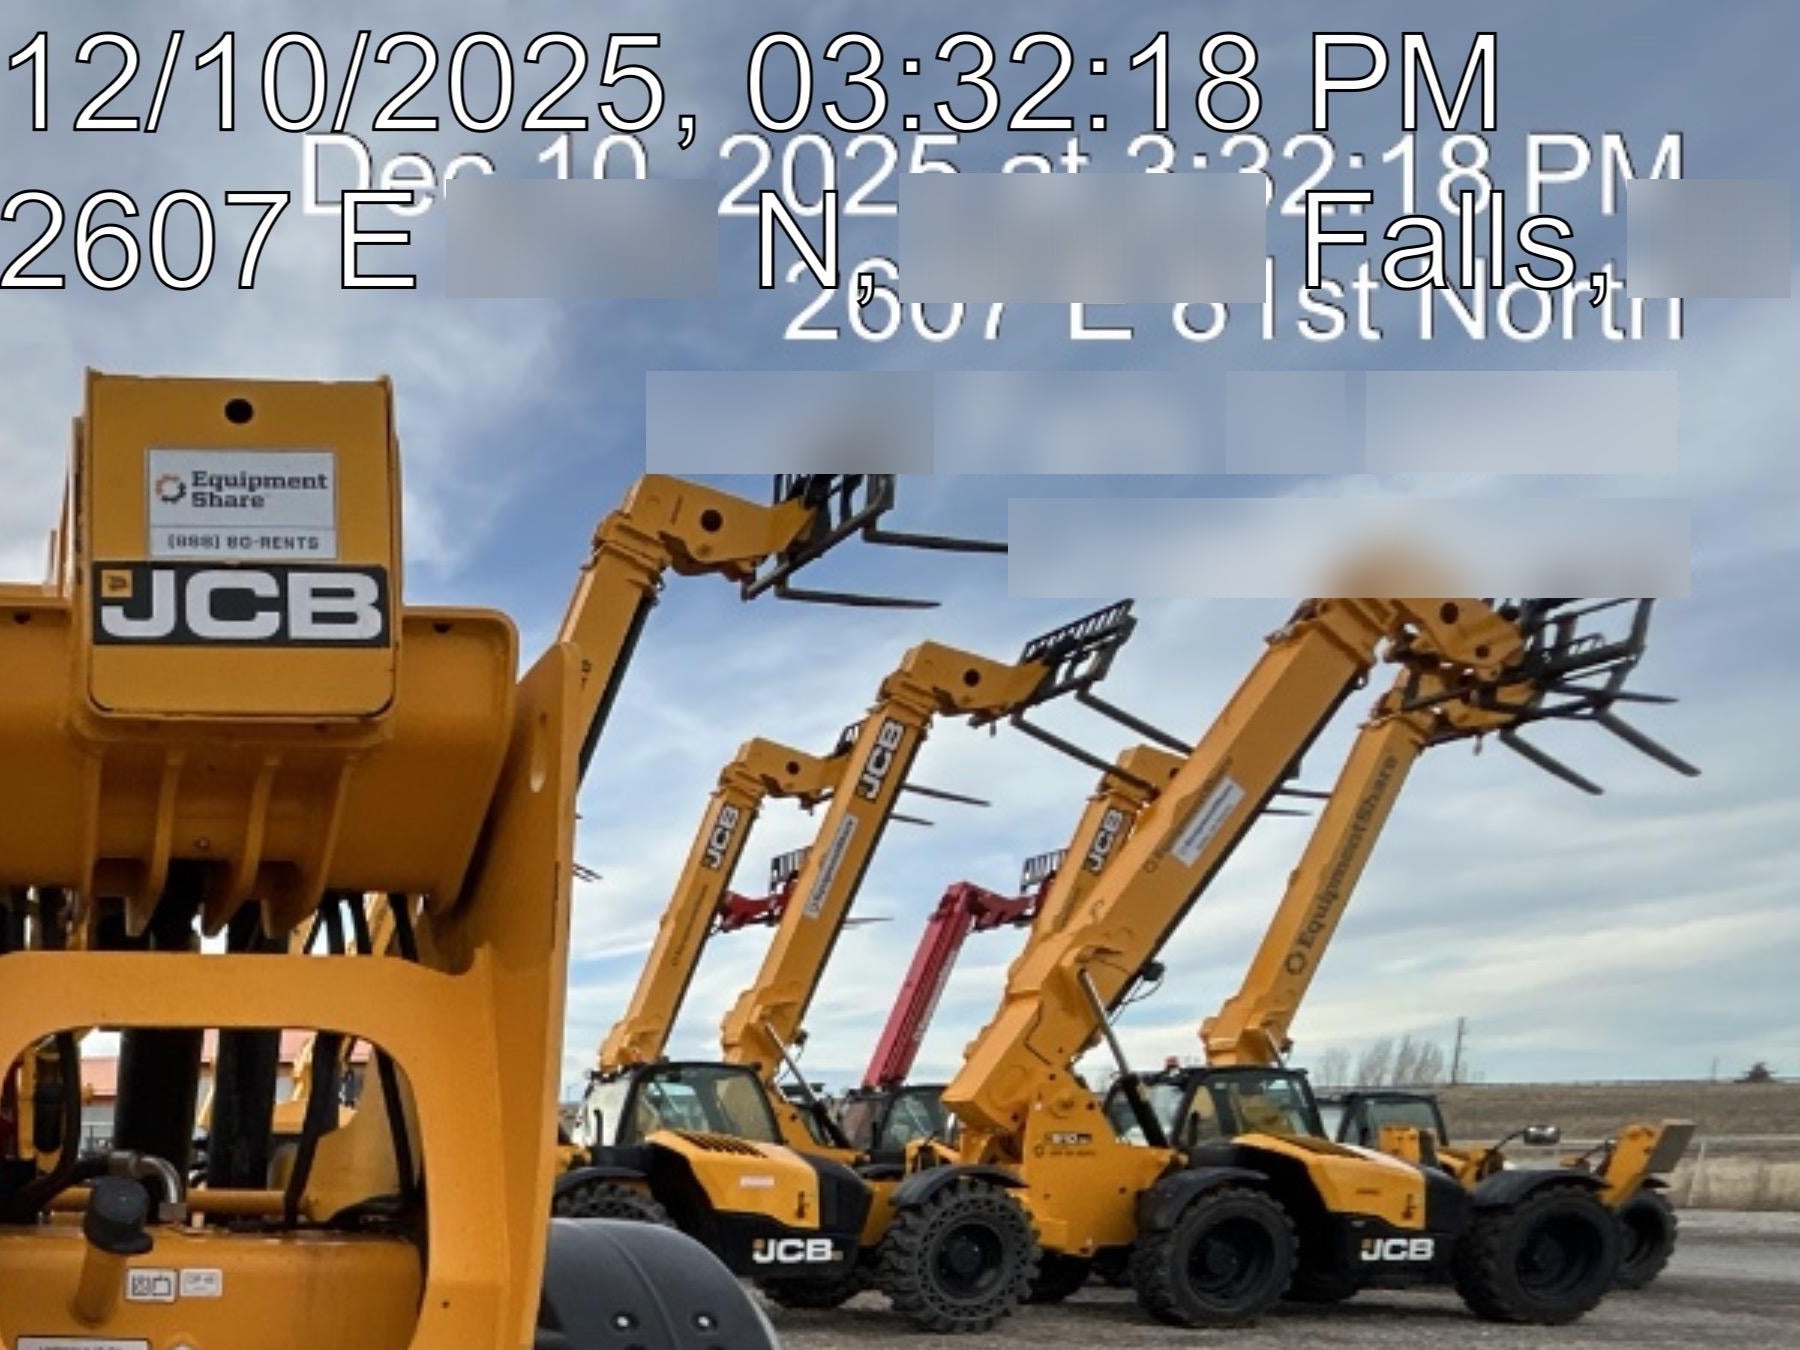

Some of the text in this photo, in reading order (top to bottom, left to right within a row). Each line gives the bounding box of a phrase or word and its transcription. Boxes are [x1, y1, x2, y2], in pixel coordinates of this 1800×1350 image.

[191, 470, 329, 492] Equipment
[191, 491, 265, 508] Share
[100, 568, 384, 641] JCB
[859, 719, 904, 799] JCB
[705, 805, 739, 869] JCB
[1086, 807, 1124, 873] JCB
[752, 1237, 834, 1264] JCB
[1359, 1237, 1435, 1261] JCB
